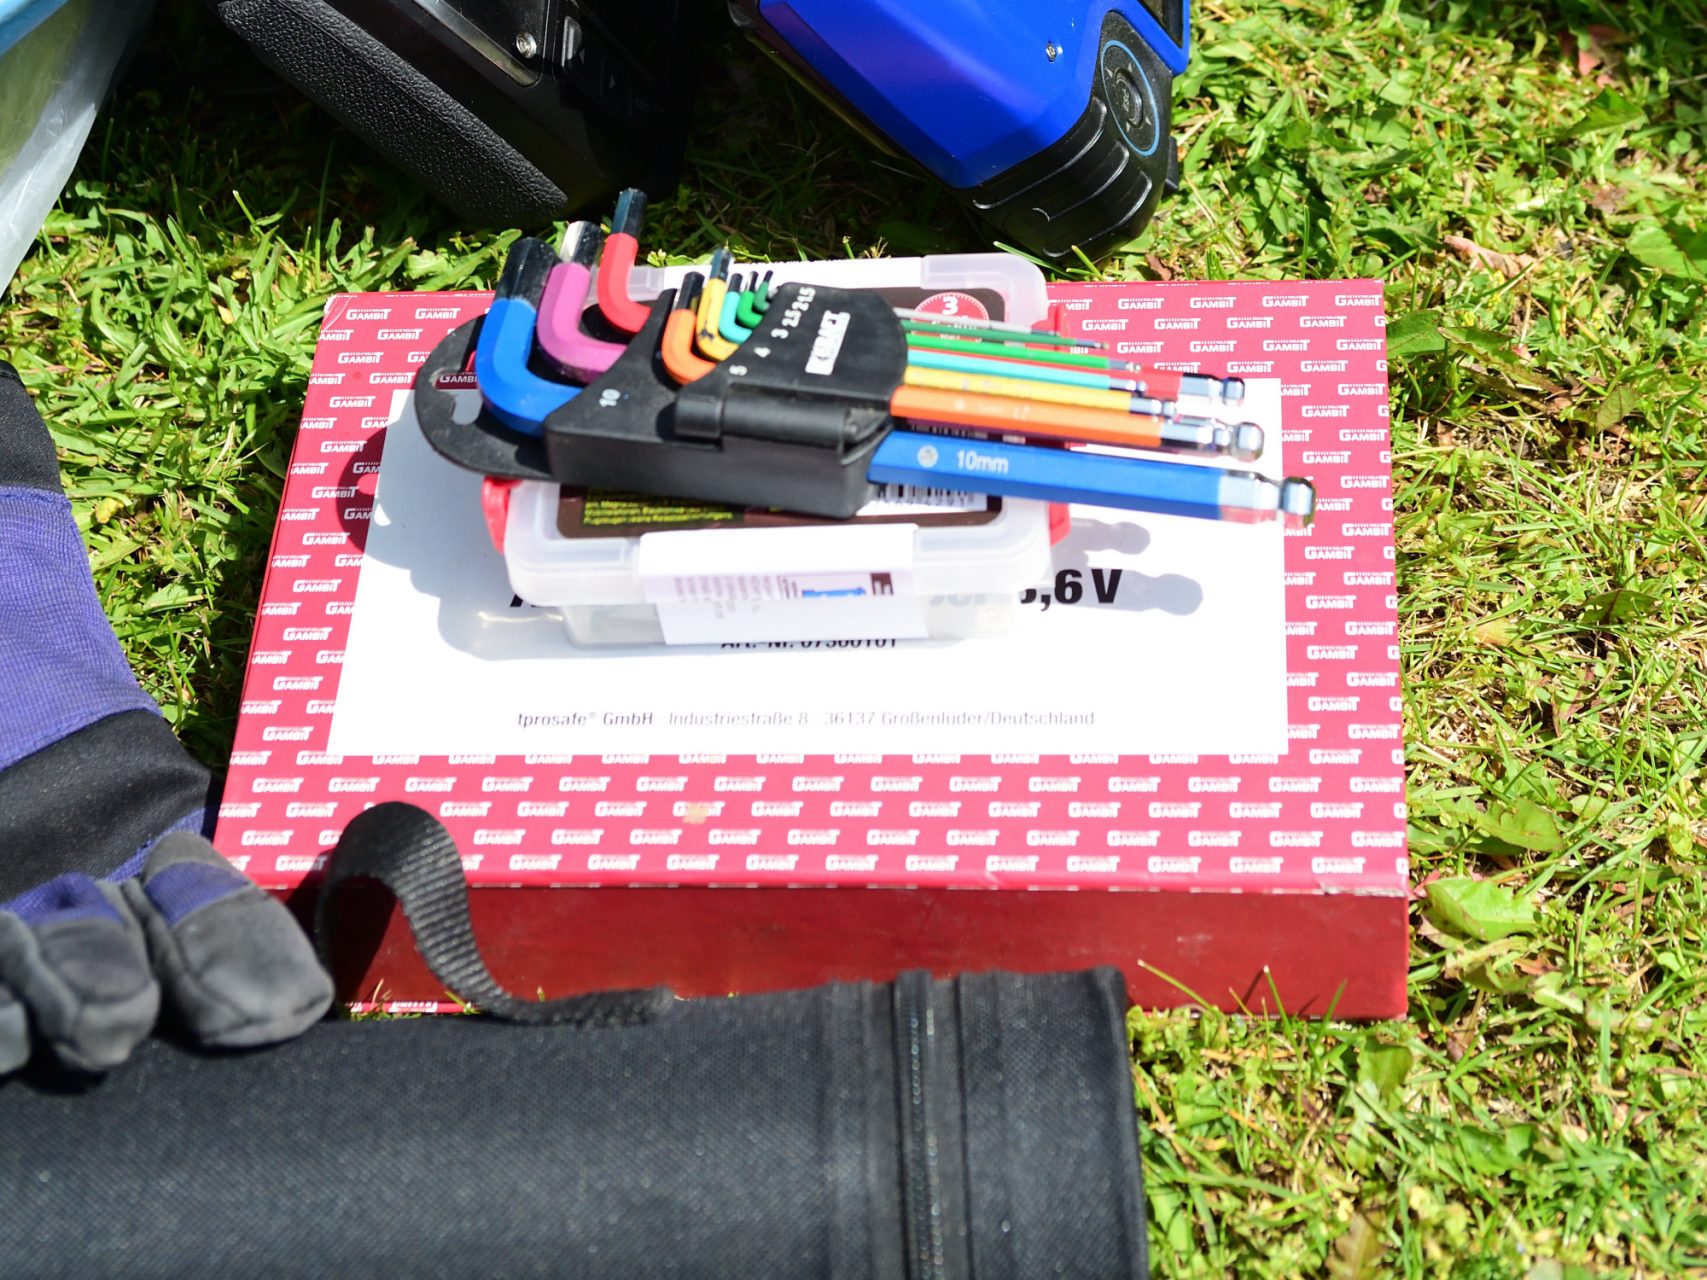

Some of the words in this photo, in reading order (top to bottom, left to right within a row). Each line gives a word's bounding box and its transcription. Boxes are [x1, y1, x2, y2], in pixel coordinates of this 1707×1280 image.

[941, 296, 959, 316] 3
[1118, 298, 1165, 309] GAMBIT
[1190, 297, 1237, 308] GAMBIT
[1262, 296, 1309, 307] GAMBIT
[1335, 294, 1382, 306] GAMBIT
[346, 309, 392, 321] GAMBIT
[415, 308, 461, 320] GAMBIT
[1082, 319, 1129, 331] GAMBIT
[1154, 318, 1201, 330] GAMBIT
[1227, 317, 1274, 329] GAMBIT
[1300, 316, 1347, 328] GAMBIT
[319, 330, 354, 342] AMBIT
[377, 329, 423, 341] GAMBIT
[771, 328, 788, 340] 3
[1117, 341, 1164, 353] GAMBIT
[1190, 340, 1237, 352] GAMBIT
[1263, 339, 1310, 351] GAMBIT
[1336, 338, 1384, 350] GAMBIT
[338, 352, 384, 364] GAMBIT
[754, 346, 771, 358] 4
[729, 365, 747, 376] 5
[1227, 361, 1275, 373] GAMBIT
[1301, 360, 1348, 372] GAMBIT
[309, 373, 346, 385] AMBIT
[369, 372, 415, 384] GAMBIT
[440, 375, 478, 383] GAMBI
[1338, 383, 1386, 395] GAMBIT
[329, 395, 376, 408] GAMBIT
[599, 388, 621, 408] 10
[1301, 405, 1350, 417] GAMBIT
[301, 416, 337, 429] AMBIT
[1339, 428, 1388, 441] GAMBIT
[320, 439, 368, 452] GAMBIT
[956, 449, 1009, 473] 10mm
[1302, 451, 1351, 464] GAMBIT
[291, 461, 329, 474] AMBIT
[1340, 475, 1390, 488] GAMBIT
[311, 485, 359, 498] GAMBIT
[1316, 498, 1353, 511] AMBIT
[281, 507, 320, 520] AMBIT
[1342, 522, 1392, 536] GAMBIT
[302, 531, 350, 544] GAMBIT
[1305, 546, 1355, 560] GAMBIT
[272, 553, 311, 567] AMBIT
[1343, 571, 1394, 585] GAMBIT
[292, 578, 342, 592] GAMBIT
[262, 601, 301, 615] AMBIT
[1306, 595, 1357, 609] GAMBIT
[283, 626, 333, 640] GAMBIT
[1345, 621, 1396, 635] GAMBIT
[252, 649, 292, 664] AMBIT
[1307, 645, 1358, 659] GAMBIT
[273, 675, 323, 690] GAMBIT
[1346, 671, 1398, 686] GAMBIT
[241, 699, 282, 714] AMBIT
[1308, 696, 1360, 711] GAMBIT
[603, 712, 653, 726] GmbH
[669, 712, 793, 727] Industriestraße
[229, 750, 272, 765] AMBIT
[219, 801, 262, 817] AMBIT
